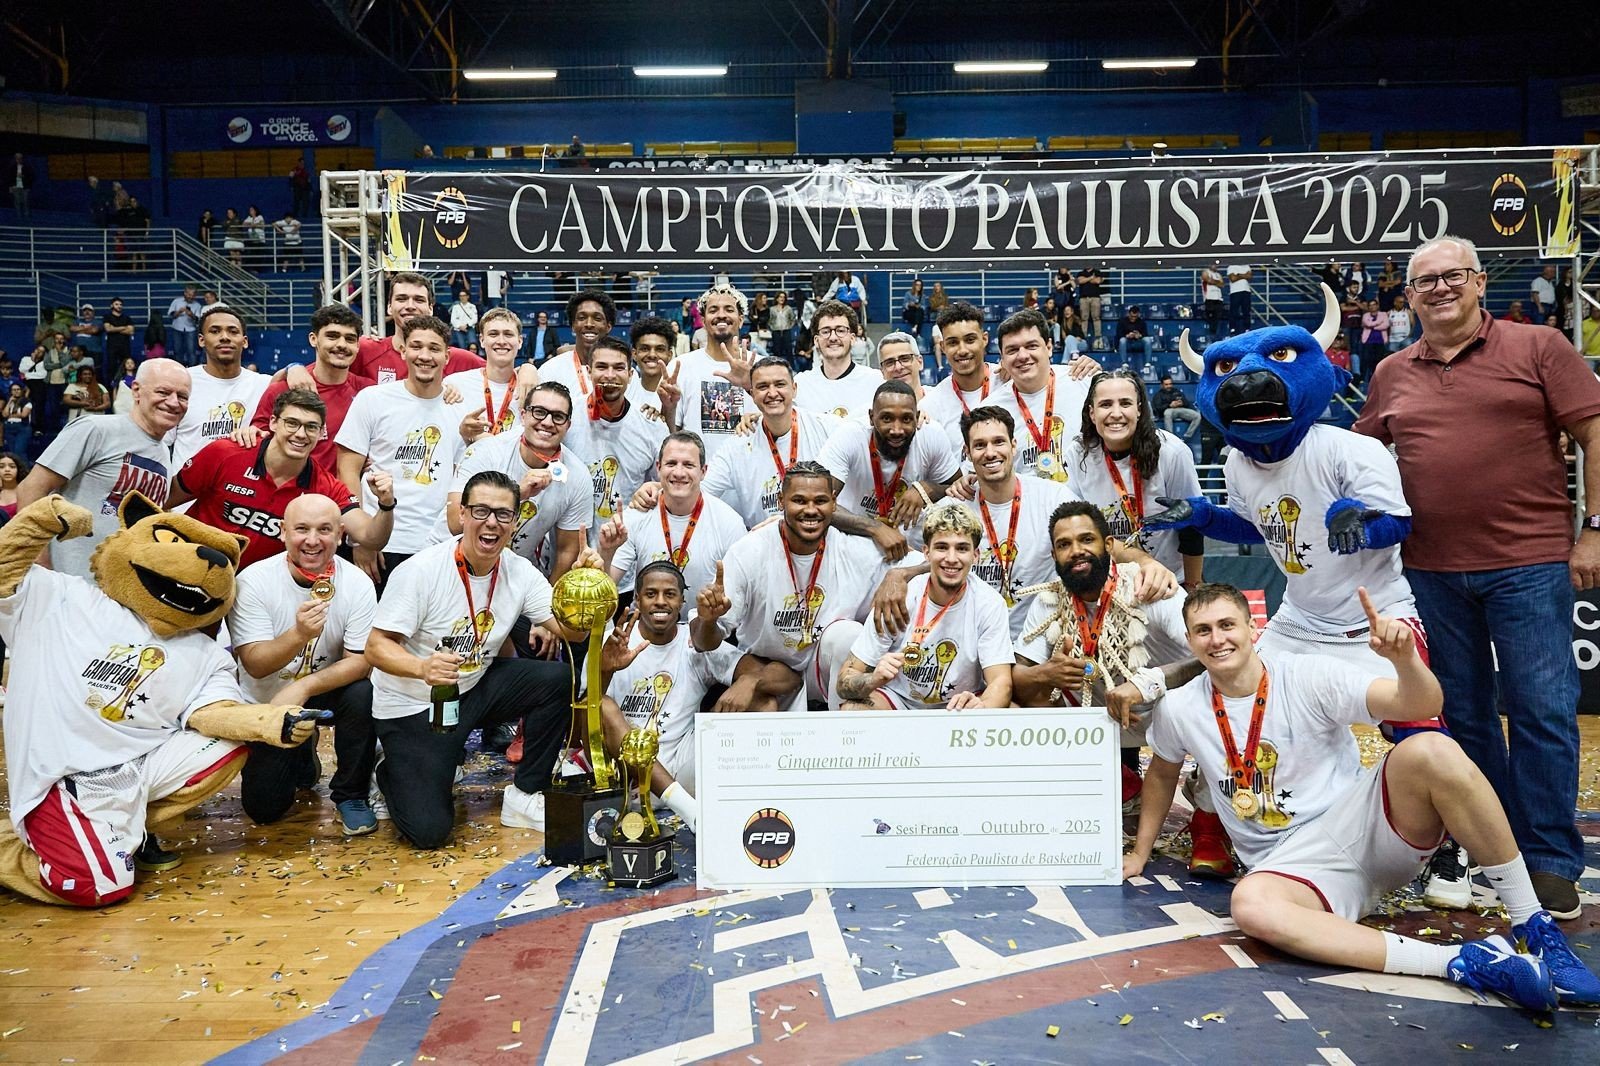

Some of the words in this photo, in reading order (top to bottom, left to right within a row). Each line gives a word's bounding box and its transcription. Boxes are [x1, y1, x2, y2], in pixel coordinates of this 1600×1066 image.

[260, 122, 310, 135] TORCE
[508, 183, 956, 253] CAMPEONATO
[972, 176, 1289, 250] PAULISTA
[1301, 170, 1449, 244] 2025
[1493, 197, 1525, 212] FPB
[436, 211, 467, 225] FPB
[202, 418, 233, 437] CAMPEÃO
[395, 443, 427, 460] CAMPEÃO
[225, 483, 255, 496] FIESP
[82, 658, 139, 687] CAMPEÃO
[87, 681, 117, 692] PAULISTA
[621, 693, 656, 713] CAMPEÃO
[720, 738, 735, 748] 101
[757, 738, 771, 747] 101
[780, 738, 794, 747] 101
[842, 737, 856, 746] 101
[949, 728, 978, 748] R$
[984, 726, 1105, 749] 50.000,00
[777, 753, 854, 772] Cinquenta
[857, 753, 881, 768] mil
[885, 752, 921, 768] reais
[895, 823, 918, 835] Sesi
[920, 823, 959, 835] Franca
[981, 819, 1045, 834] Outubro
[1065, 819, 1101, 833] 2025
[748, 832, 790, 845] FPB
[622, 854, 639, 873] V
[654, 849, 667, 871] P
[905, 853, 967, 868] Federação
[970, 852, 1019, 865] Paulista
[1021, 852, 1035, 864] de
[1038, 851, 1102, 865] Basketball
